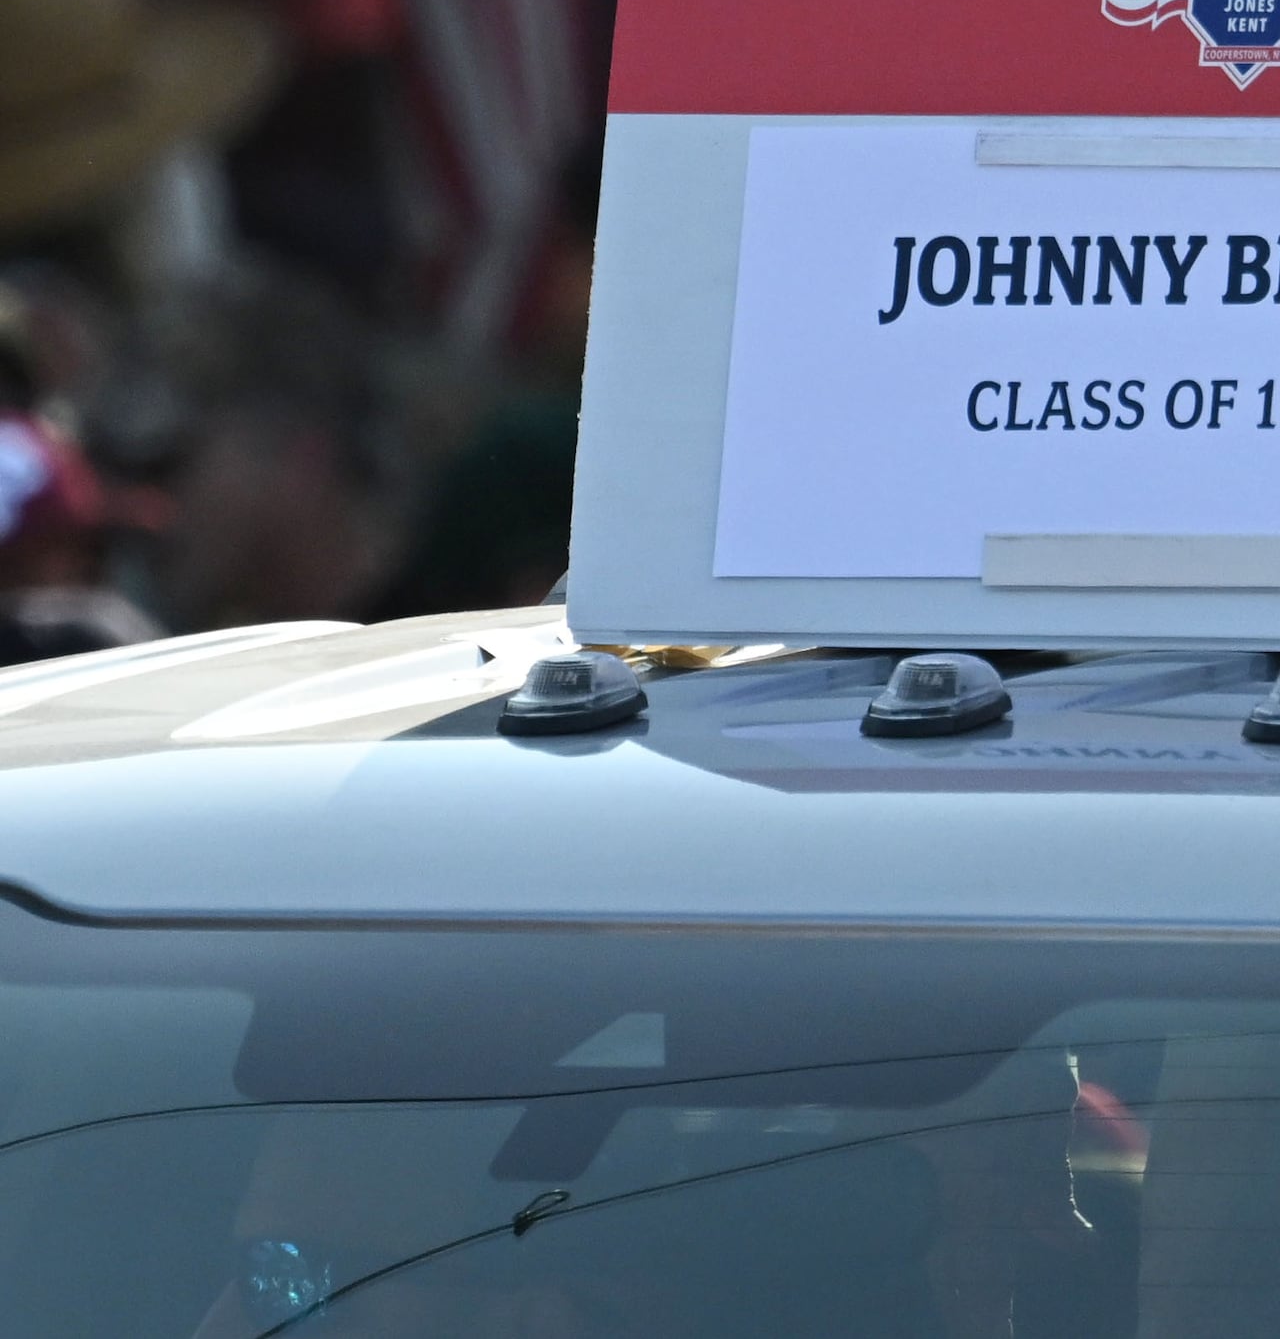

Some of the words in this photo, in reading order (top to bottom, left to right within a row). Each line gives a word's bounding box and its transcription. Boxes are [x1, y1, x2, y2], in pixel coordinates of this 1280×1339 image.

[1227, 17, 1268, 32] KENT
[1204, 49, 1271, 61] COOPERSTOWN,
[878, 233, 1207, 326] JOHNNY
[966, 378, 1146, 433] CLASS
[1163, 378, 1240, 430] OF
